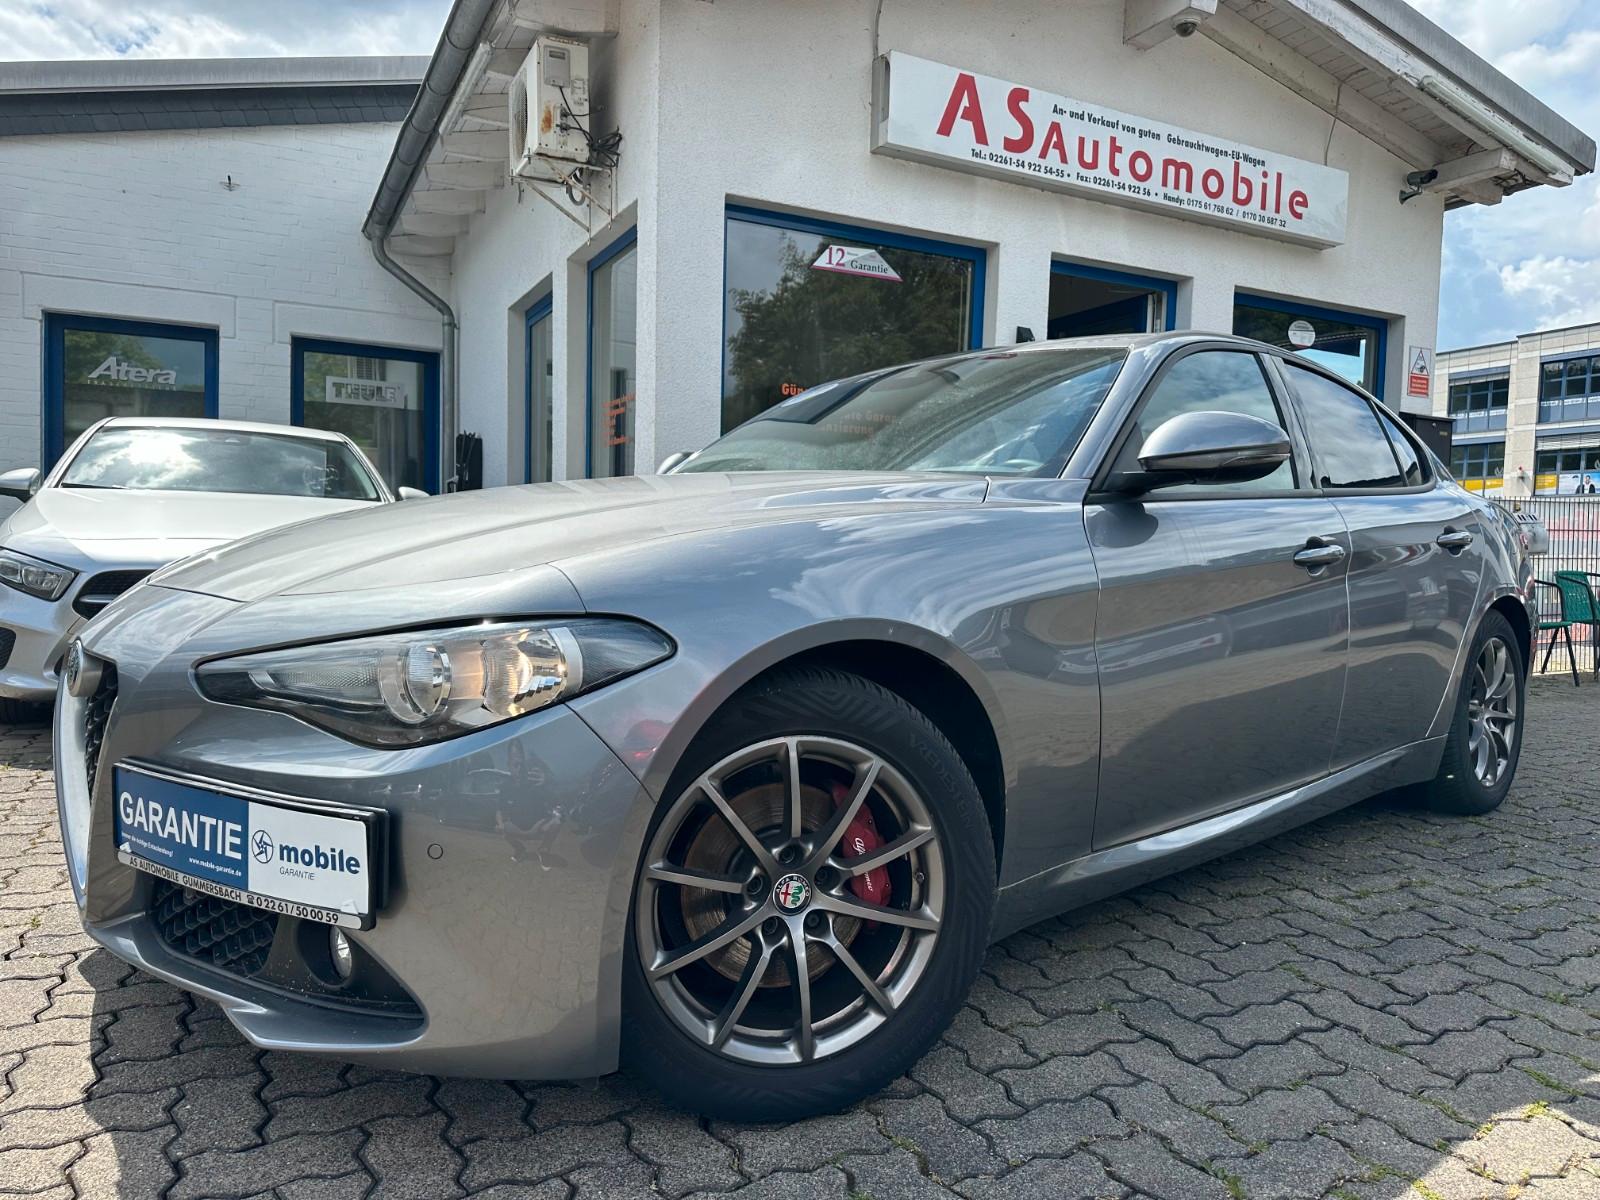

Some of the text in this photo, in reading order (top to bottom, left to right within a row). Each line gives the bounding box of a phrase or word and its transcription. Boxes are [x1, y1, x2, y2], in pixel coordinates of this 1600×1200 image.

[1052, 103, 1067, 116] An-
[1069, 110, 1085, 121] und
[1087, 112, 1120, 130] Verkauf
[1121, 123, 1136, 135] von
[1138, 128, 1161, 141] guten
[971, 148, 987, 160] Tel.:
[988, 152, 1025, 169] 02261-54
[1027, 163, 1042, 173] 922
[1044, 167, 1065, 178] 54-55
[1076, 172, 1091, 184] Fax:
[1093, 177, 1126, 191] 02261-54
[1128, 183, 1141, 195] 922
[1142, 187, 1151, 198] 56
[1163, 192, 1185, 207] Handy:
[1038, 120, 1309, 220] Automobile
[825, 246, 846, 267] 12
[851, 260, 889, 274] Garantie
[88, 356, 177, 385] Atera
[332, 382, 397, 402] THULE
[119, 791, 242, 860] GARANTIE
[279, 843, 361, 875] mobile
[279, 866, 316, 881] GARANTIE
[129, 857, 138, 867] AS
[139, 860, 179, 882] AUTOMOBILE
[182, 875, 241, 902] GUMMERSBACH
